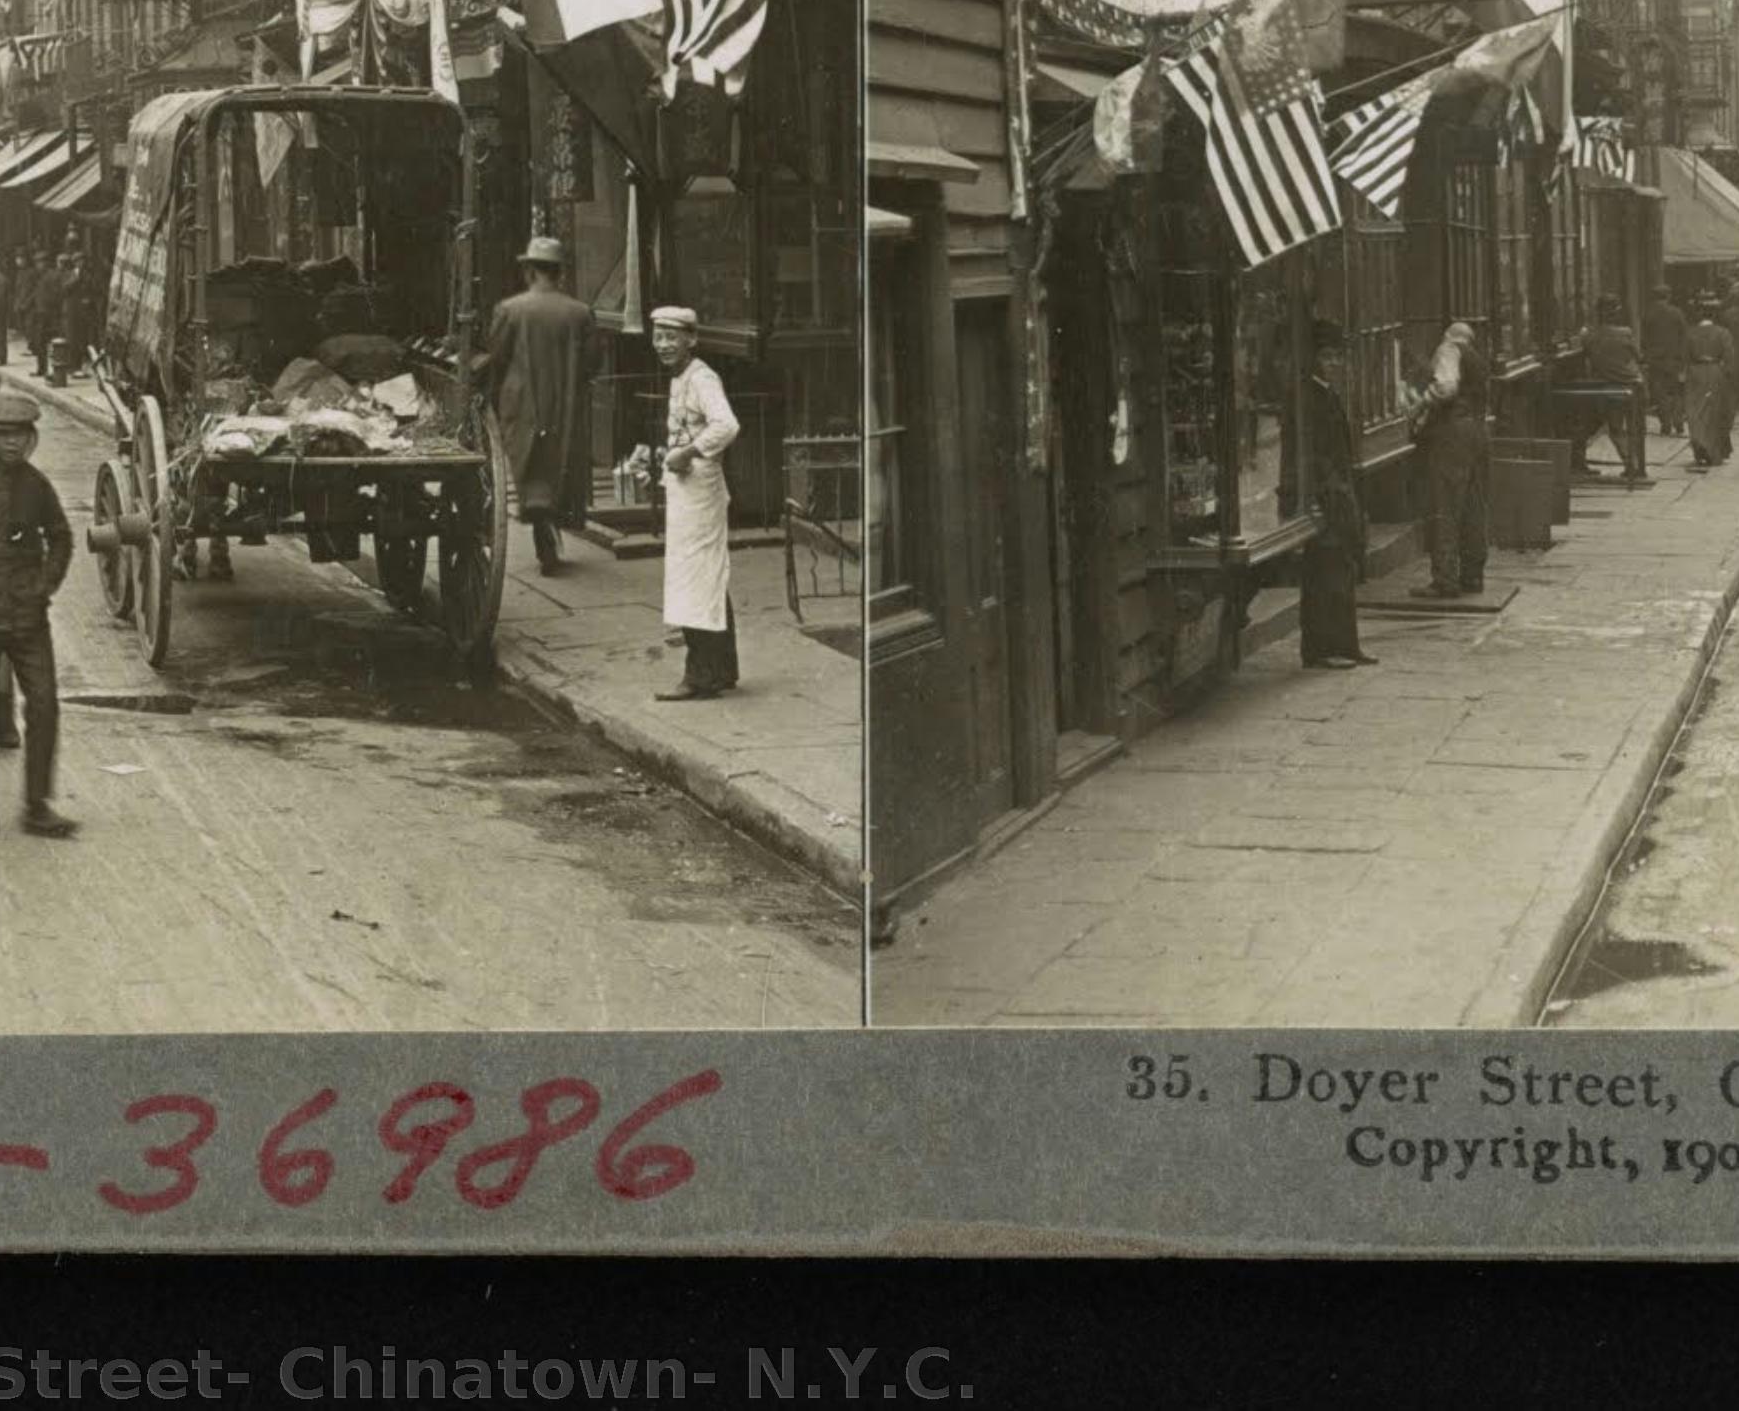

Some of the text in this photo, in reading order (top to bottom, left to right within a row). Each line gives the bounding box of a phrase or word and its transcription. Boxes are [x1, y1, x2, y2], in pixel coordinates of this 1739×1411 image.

[1126, 1054, 1208, 1101] 35.
[1252, 1052, 1439, 1113] Doyer
[1480, 1054, 1678, 1114] Street,
[1345, 1125, 1641, 1185] Copyright,
